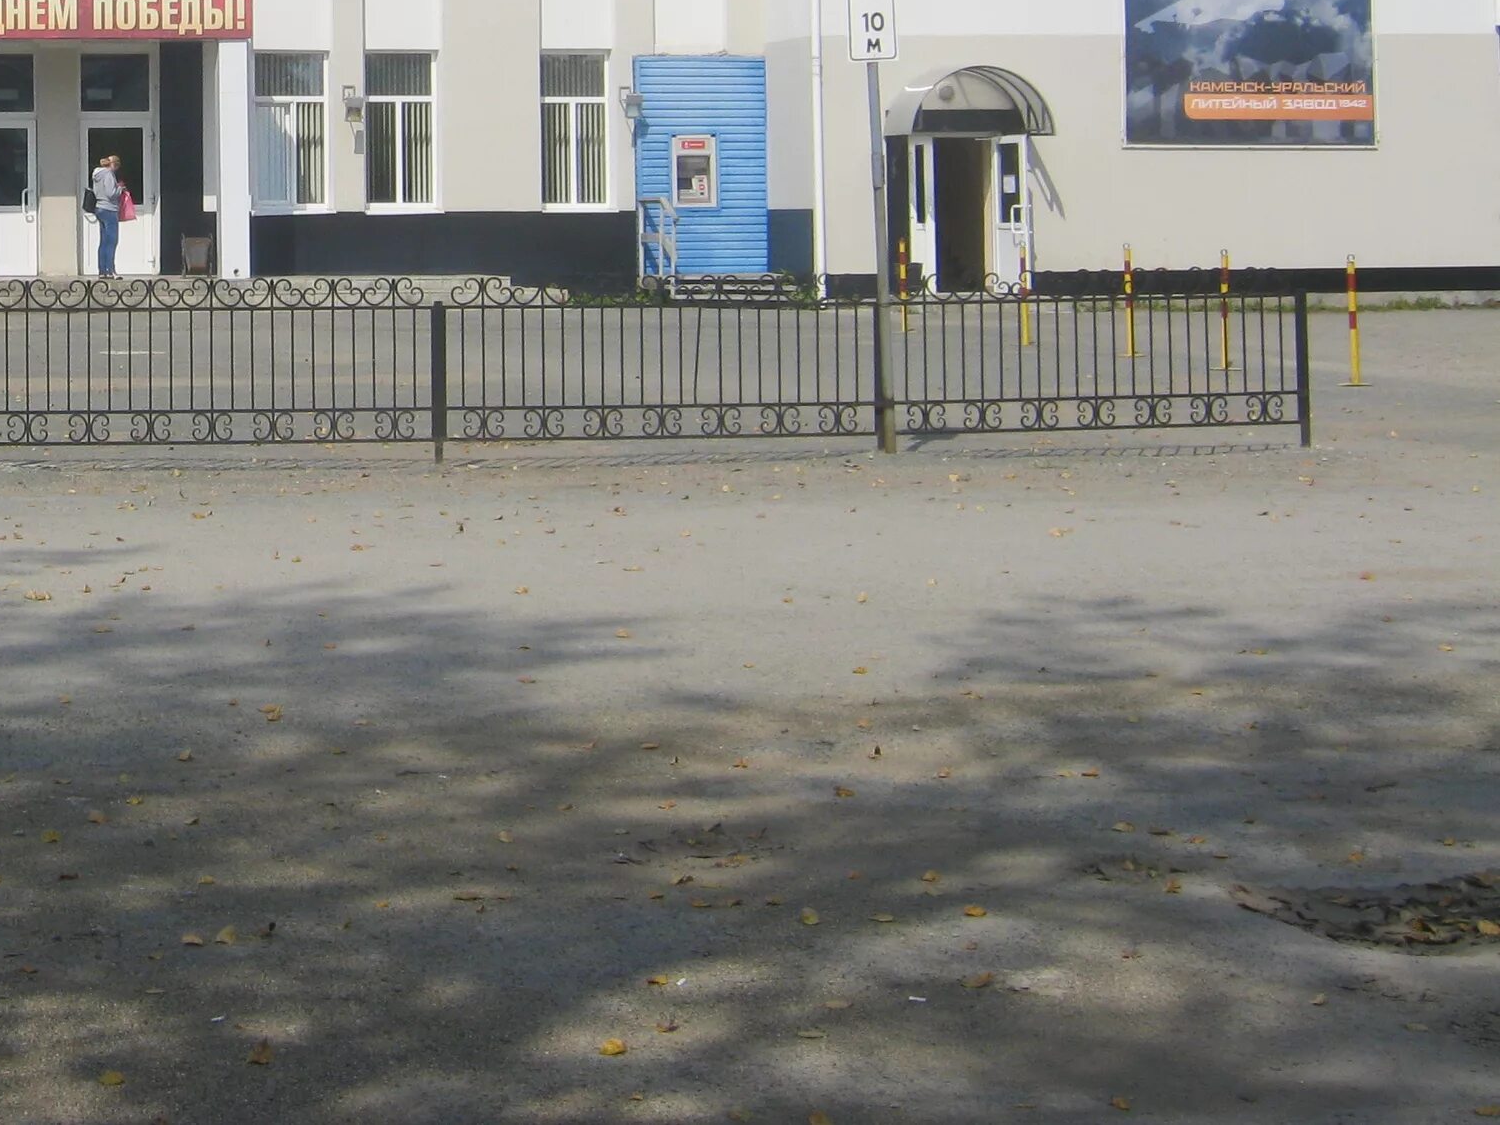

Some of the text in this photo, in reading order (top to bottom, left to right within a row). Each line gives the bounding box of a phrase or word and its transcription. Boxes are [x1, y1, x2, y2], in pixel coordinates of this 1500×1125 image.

[862, 12, 885, 33] 10
[1190, 80, 1366, 93] КАМЕНСК-УРАЛЬСКИЙ
[1191, 96, 1277, 110] ЛИТЕЙНЫЙ
[1282, 98, 1337, 110] ЗАВОД
